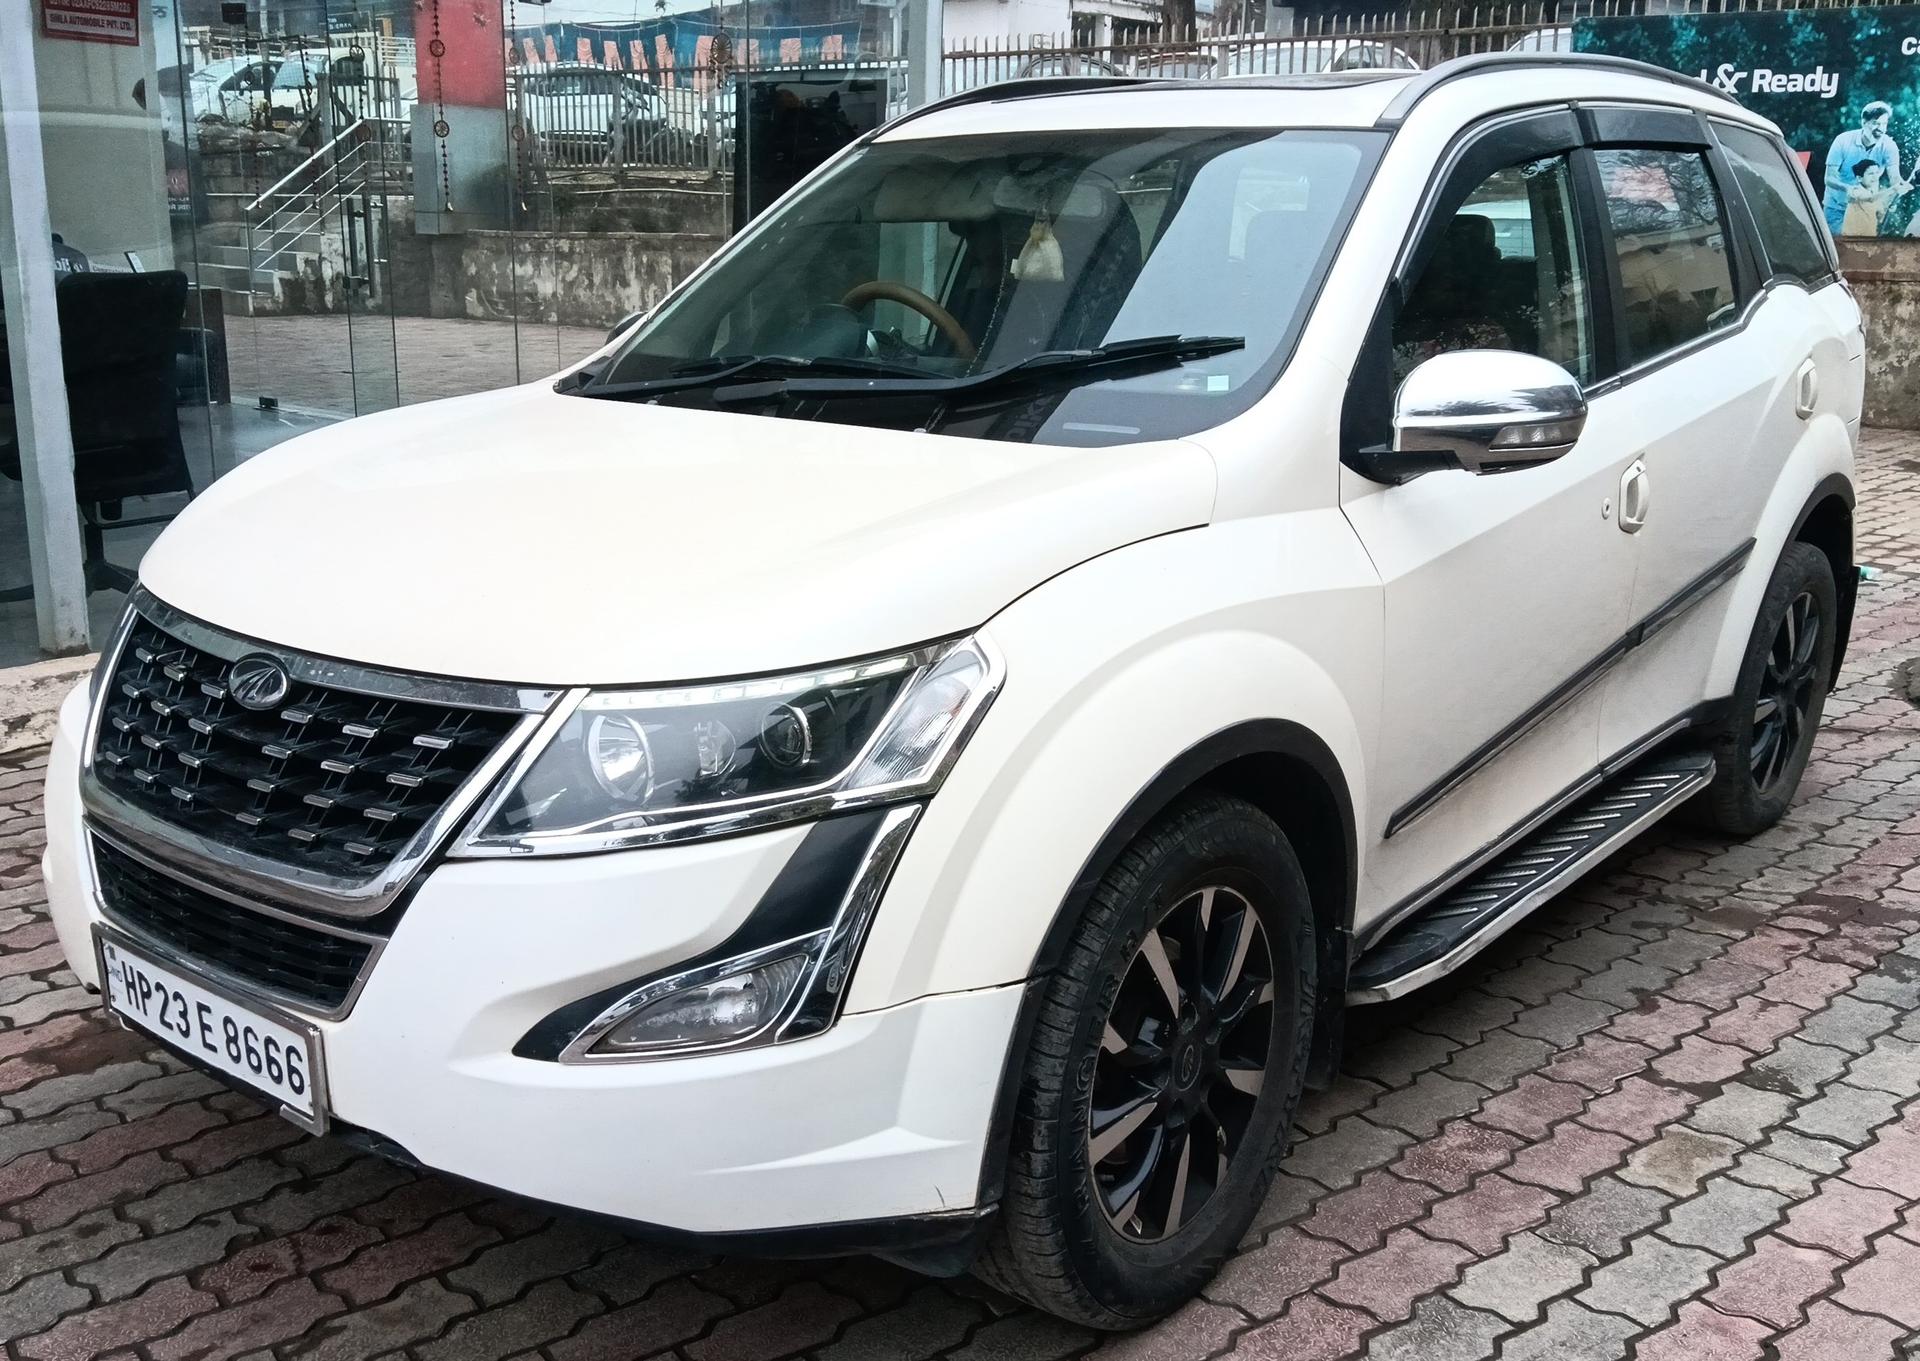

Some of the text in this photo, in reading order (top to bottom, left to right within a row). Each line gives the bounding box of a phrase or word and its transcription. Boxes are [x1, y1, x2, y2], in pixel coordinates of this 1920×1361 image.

[70, 15, 104, 27] AUTOMOBILE
[1711, 63, 1748, 94] &
[1751, 66, 1840, 98] Ready
[121, 961, 306, 1096] HP23 E 8666
